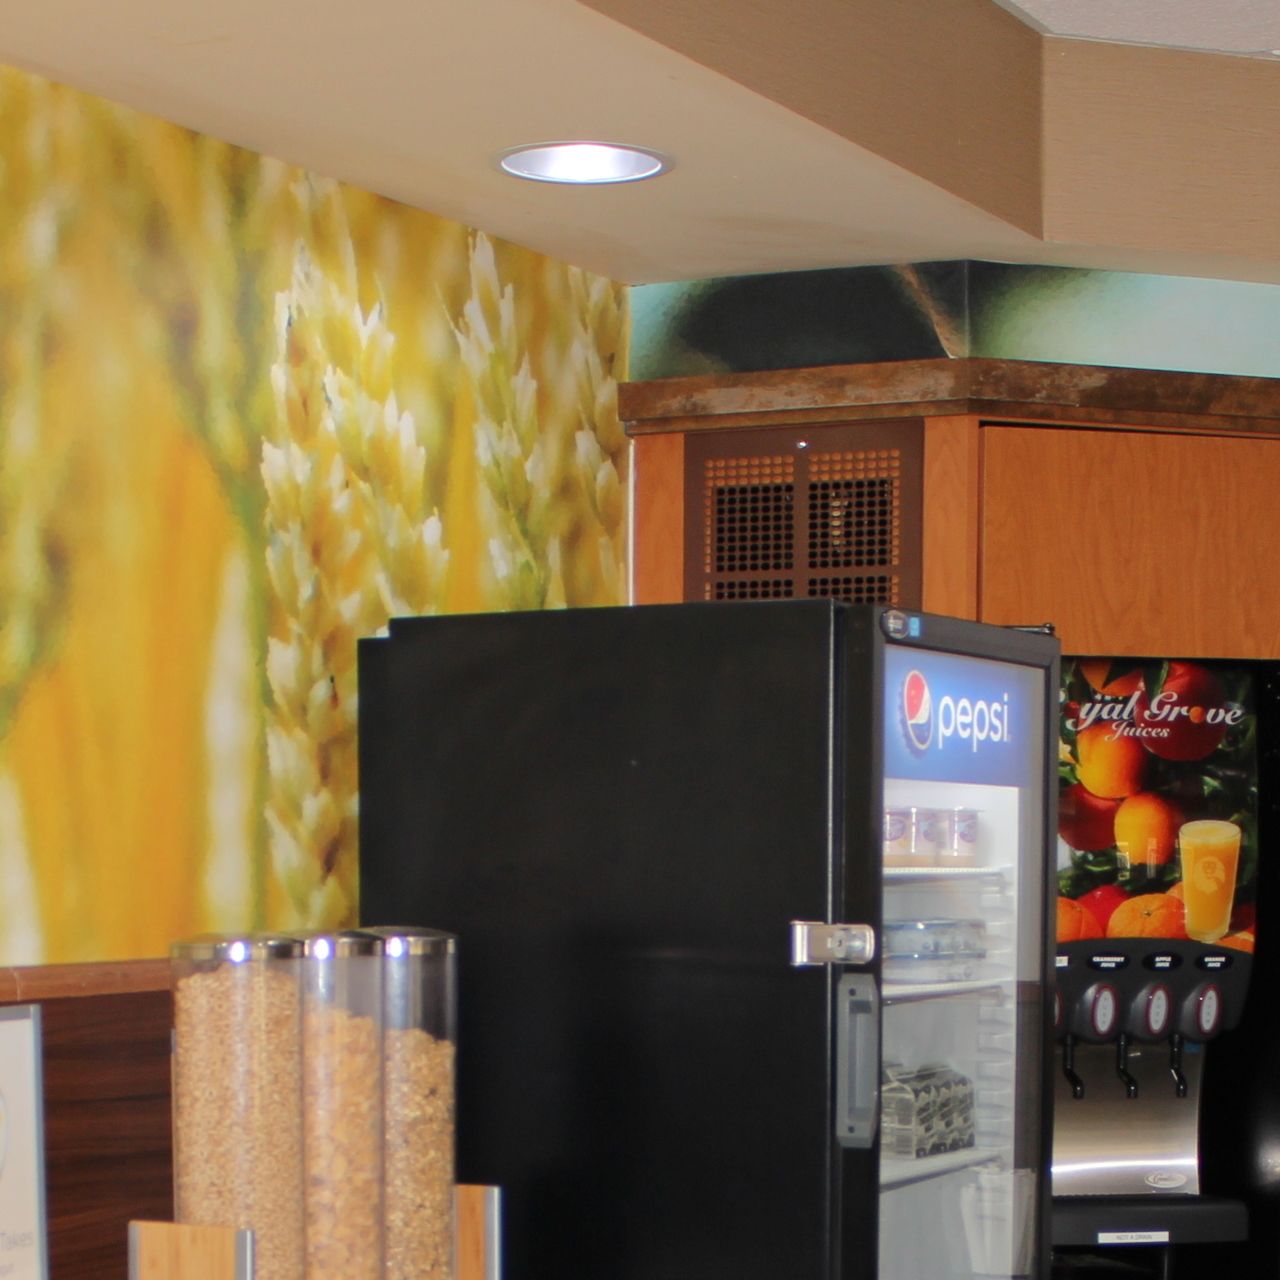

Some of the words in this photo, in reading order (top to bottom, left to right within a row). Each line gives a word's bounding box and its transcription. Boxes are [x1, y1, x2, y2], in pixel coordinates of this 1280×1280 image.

[938, 692, 1009, 753] pepsi
[1144, 691, 1244, 725] Grove
[1104, 719, 1170, 742] Juices
